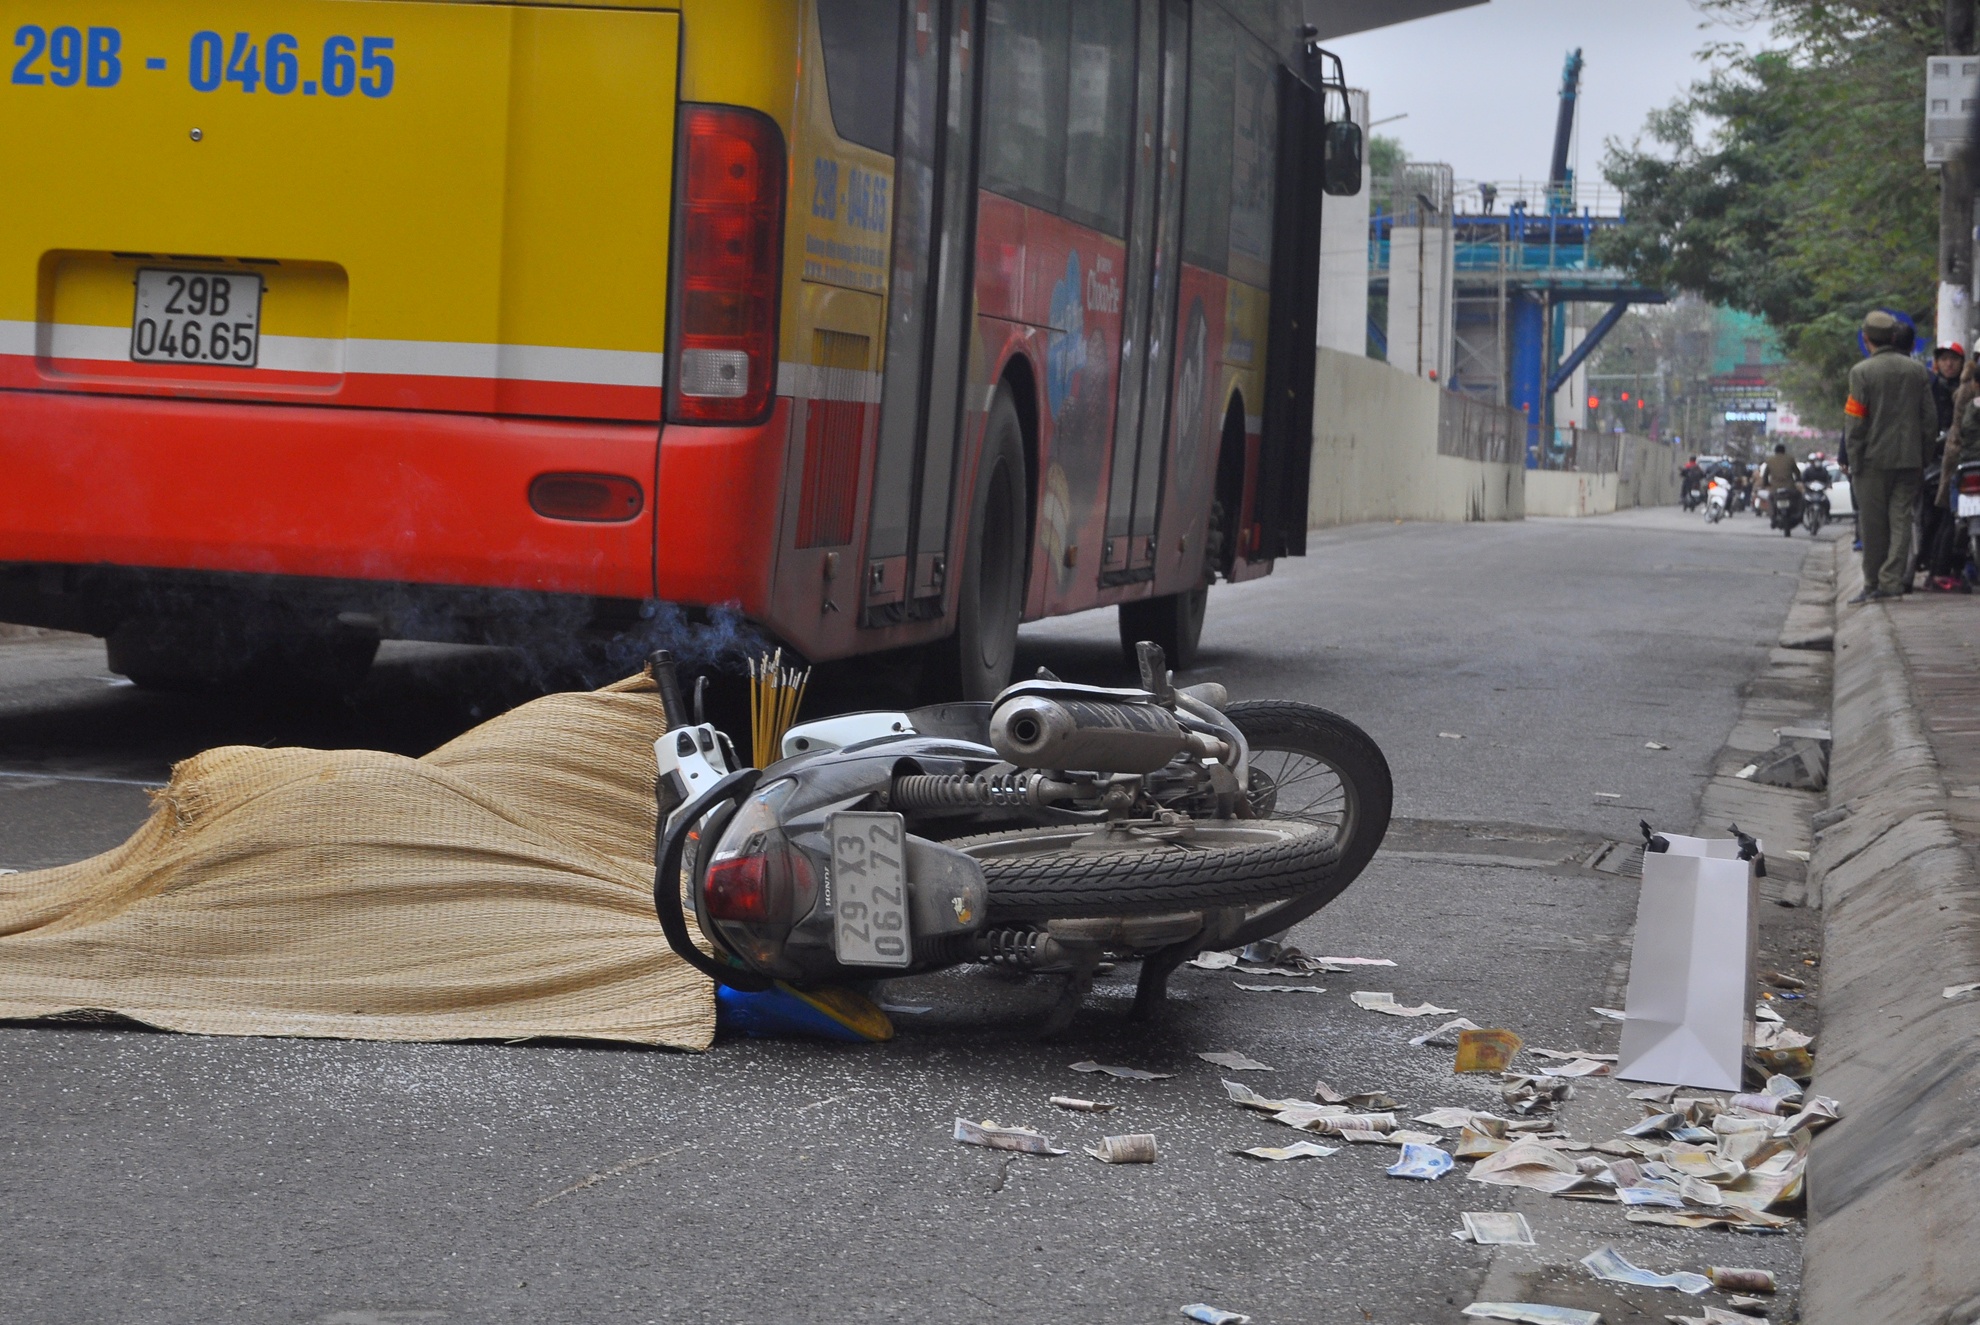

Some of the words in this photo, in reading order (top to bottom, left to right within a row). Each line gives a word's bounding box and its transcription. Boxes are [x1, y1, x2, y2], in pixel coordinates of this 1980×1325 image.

[11, 24, 122, 88] 29B
[188, 30, 395, 98] 046.65
[812, 156, 838, 219] 29B
[165, 275, 231, 316] 29B
[137, 318, 254, 361] 046.65
[837, 835, 871, 943] 29-X3
[869, 824, 905, 956] 062.72
